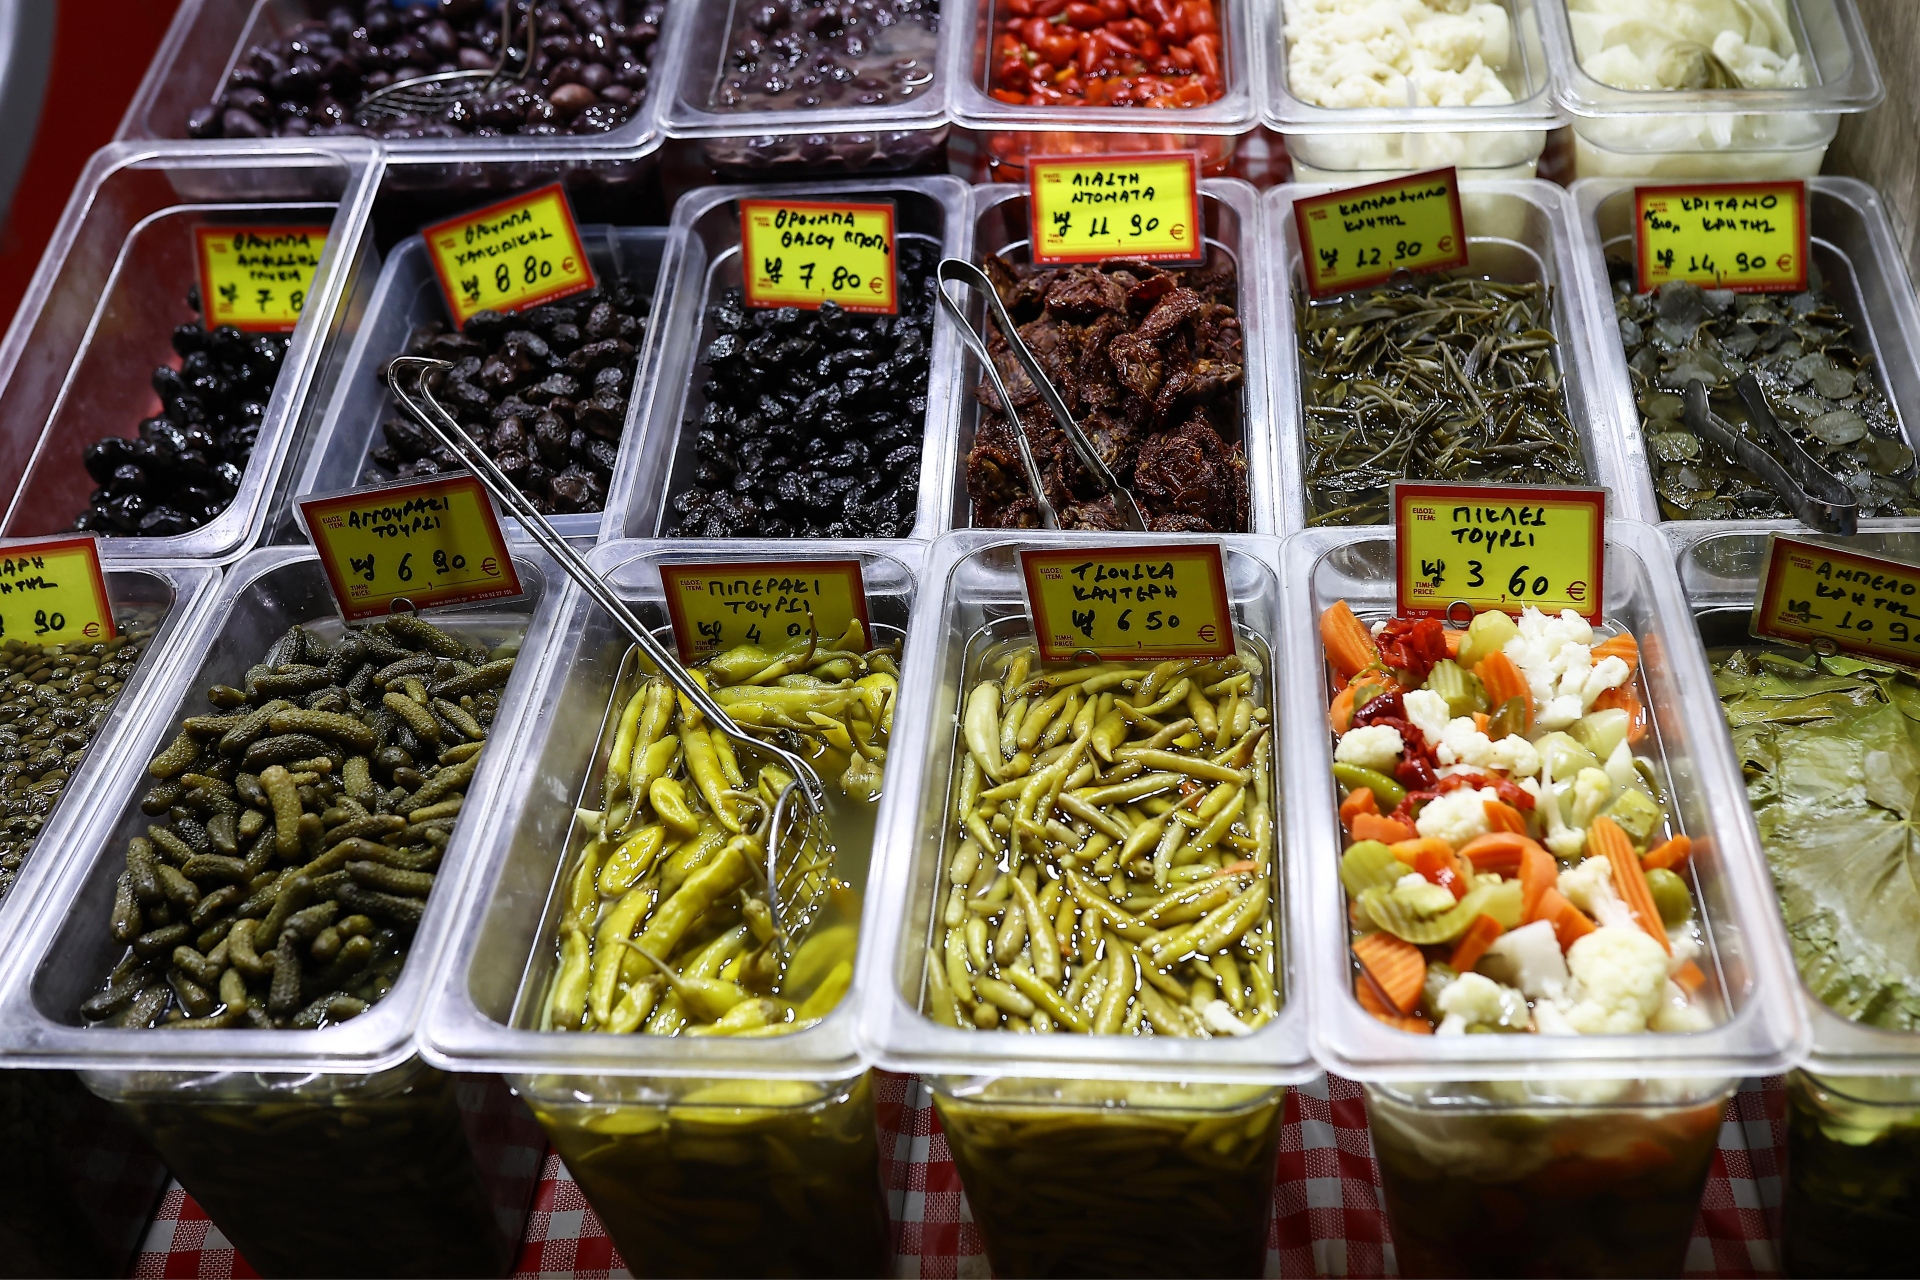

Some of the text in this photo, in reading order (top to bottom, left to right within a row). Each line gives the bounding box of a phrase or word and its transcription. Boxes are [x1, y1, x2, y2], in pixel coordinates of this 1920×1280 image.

[1073, 172, 1139, 187] ΛΙΑΣΤΗ
[1072, 186, 1155, 204] ΝΤΟΜΑΤΑ
[1681, 194, 1778, 211] ΚΡΙΤΑΜΟ
[465, 209, 532, 245] ΘΡΟΥΜΠΑ
[775, 209, 854, 229] ΘΡΟΥΜΠΑ
[1344, 215, 1406, 232] ΚΡΗΤΗΣ
[1702, 217, 1775, 233] ΚΡΗΤΗΣ
[781, 231, 834, 250] ΘΑΣΟΥ
[348, 497, 449, 530] ΑΓΓΟΥΡΑΚΙ
[1453, 507, 1546, 526] ΠΙΚΛΕΣ
[371, 516, 441, 538] ΤΟΥΡΣΙ
[1451, 528, 1535, 553] ΤΟΥΡΣΙ
[0, 556, 44, 577] ΑΡΗ
[480, 557, 500, 576] €
[1071, 561, 1174, 583] ΤΣΟΥΣΚΑ
[708, 578, 820, 596] ΠΙΠΕΡΑΚΙ
[1073, 584, 1177, 604] ΚΑΥΤΕΡΗ
[1566, 581, 1587, 602] €
[723, 596, 810, 618] ΤΟΥΡΣΙ
[82, 622, 100, 638] €
[1197, 624, 1217, 643] €
